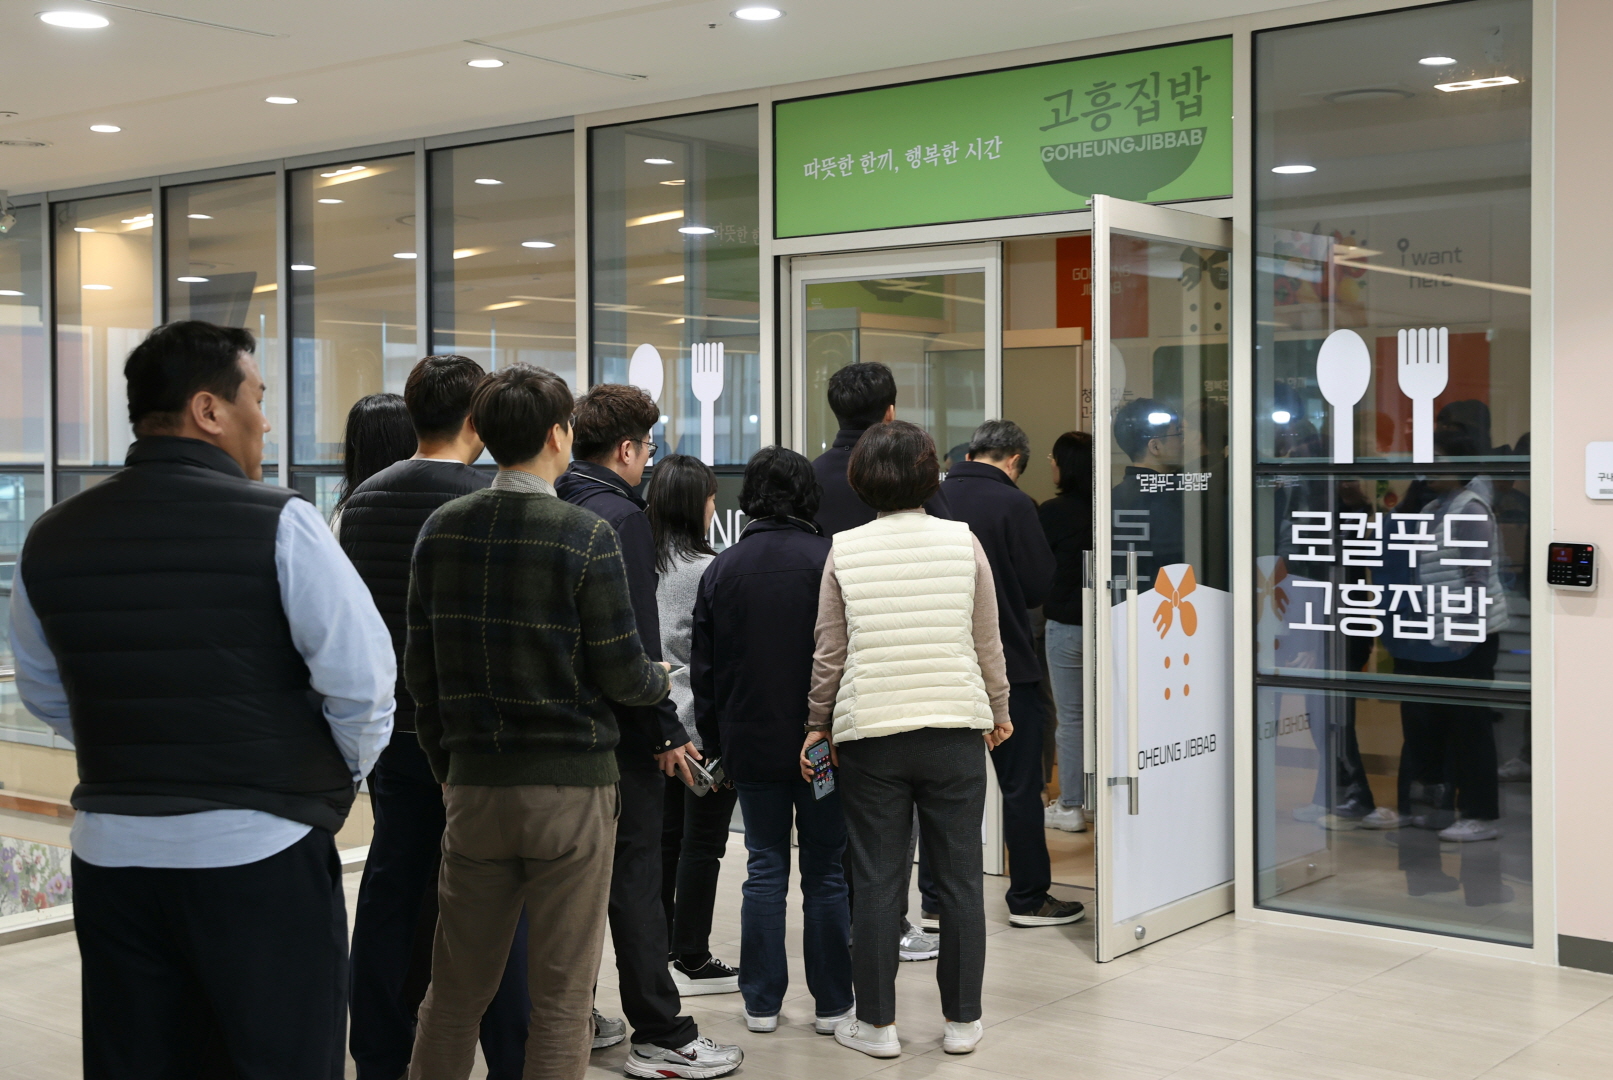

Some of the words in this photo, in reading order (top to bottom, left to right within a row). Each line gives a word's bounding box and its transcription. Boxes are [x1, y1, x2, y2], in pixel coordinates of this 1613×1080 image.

[1039, 66, 1211, 132] 고흥집밥
[803, 154, 855, 180] 따뜻한
[859, 149, 899, 174] 한끼,
[905, 141, 960, 169] 행복한
[965, 135, 1003, 161] 시간
[1041, 128, 1203, 163] GOHEUNGJIBBAB
[1412, 247, 1462, 266] want
[1288, 511, 1492, 568] 로컬푸드
[1288, 579, 1494, 643] 고흥집밥
[1138, 742, 1181, 770] OHEUNG
[1183, 734, 1217, 759] JIBBAB
